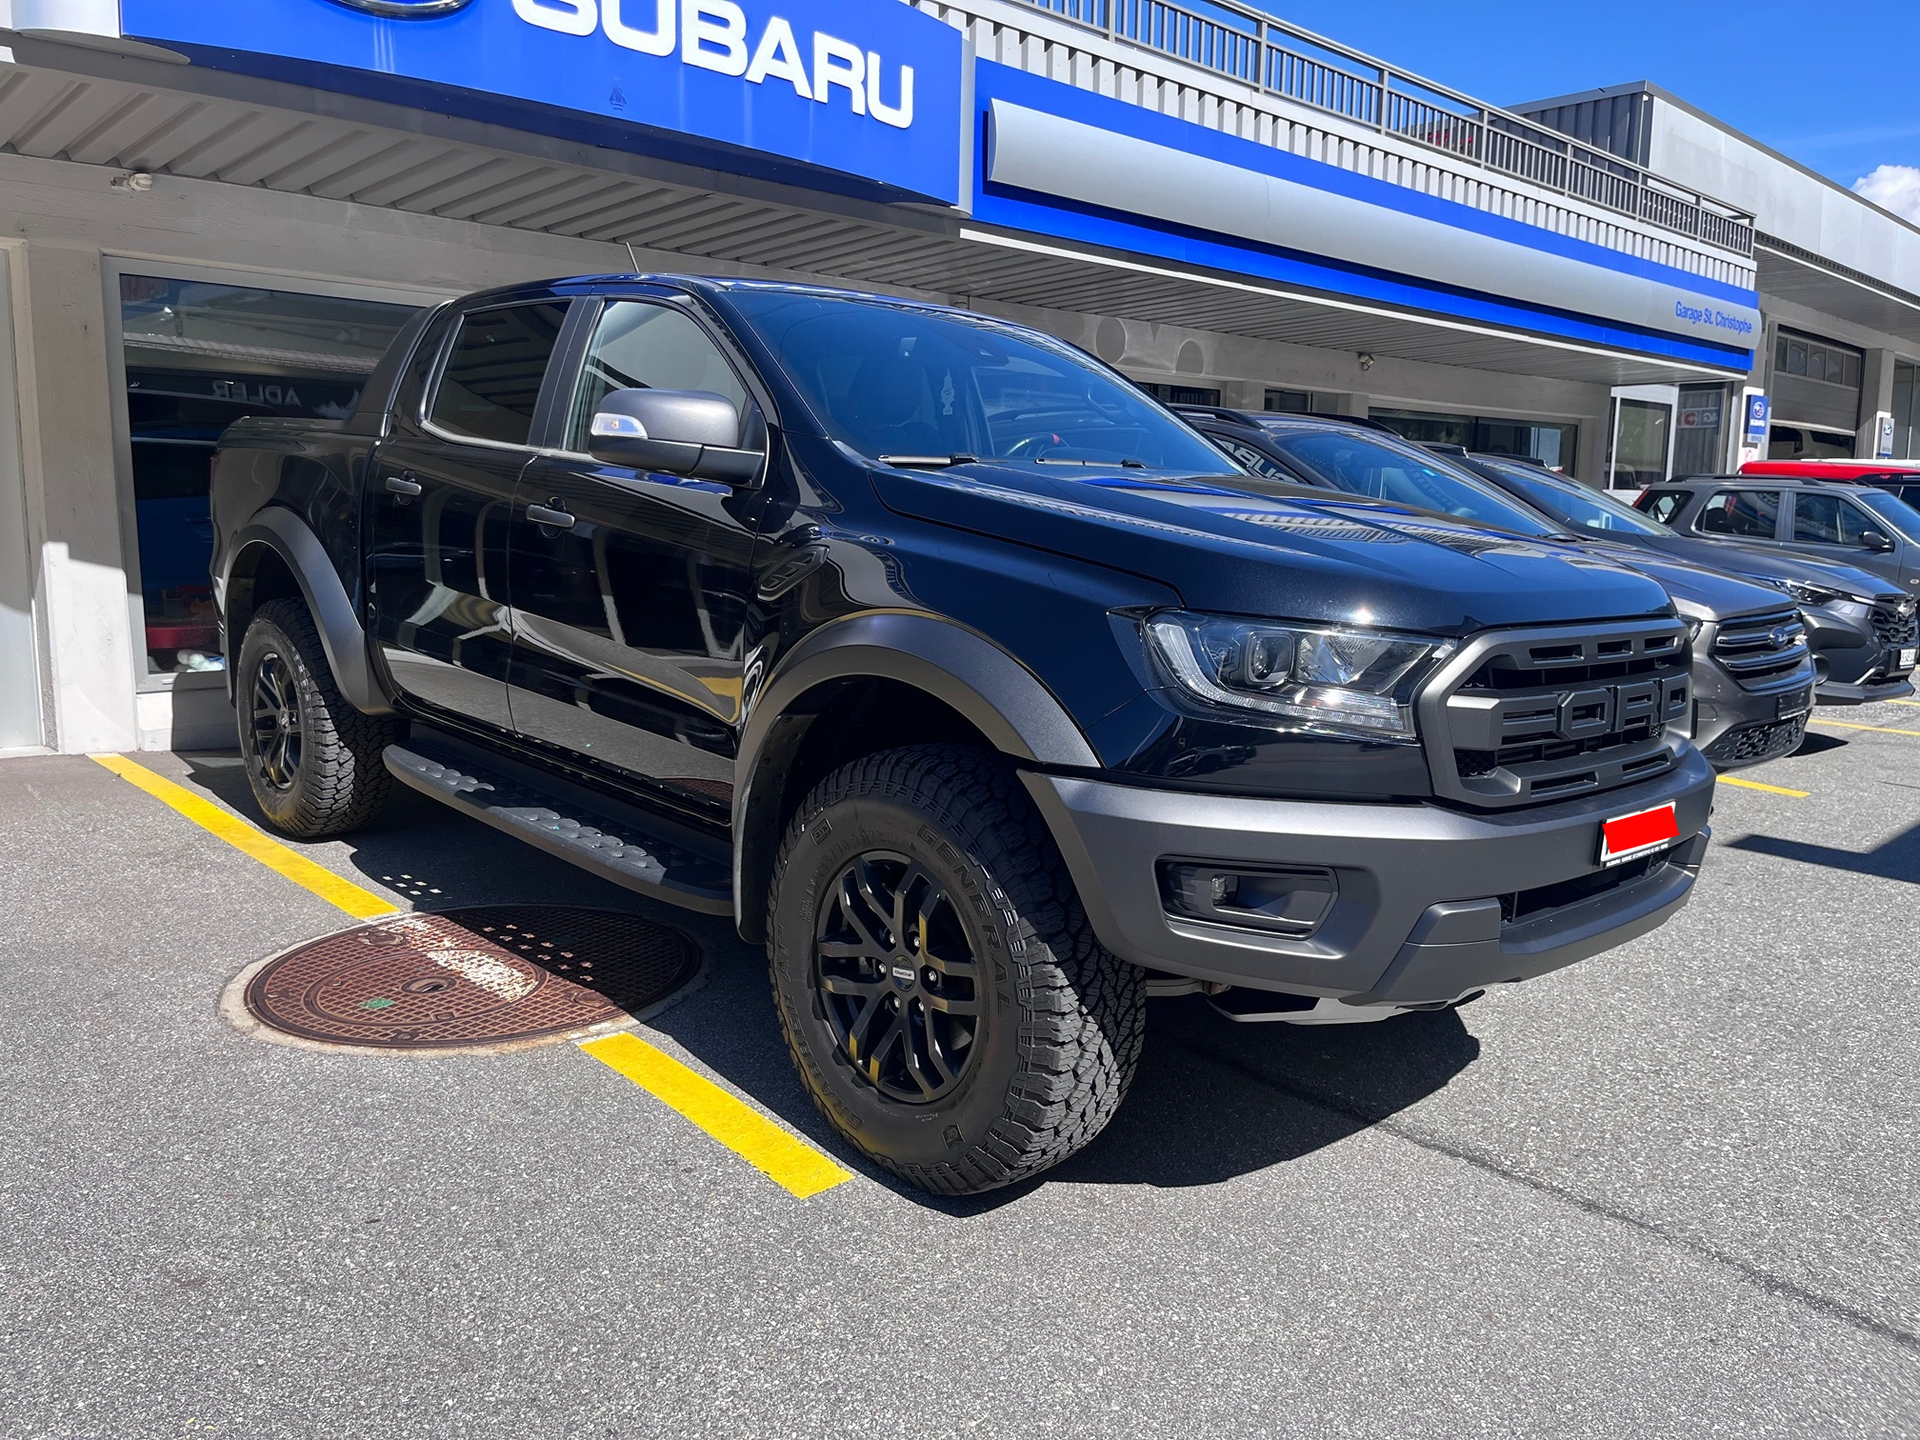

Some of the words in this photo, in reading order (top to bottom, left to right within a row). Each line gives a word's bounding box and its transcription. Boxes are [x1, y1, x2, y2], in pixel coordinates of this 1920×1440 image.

[1675, 301, 1703, 325] Garage
[1704, 308, 1714, 325] St.
[1715, 311, 1753, 335] Christophe
[1447, 672, 1693, 750] FORD
[917, 823, 1012, 1016] GENERAL
